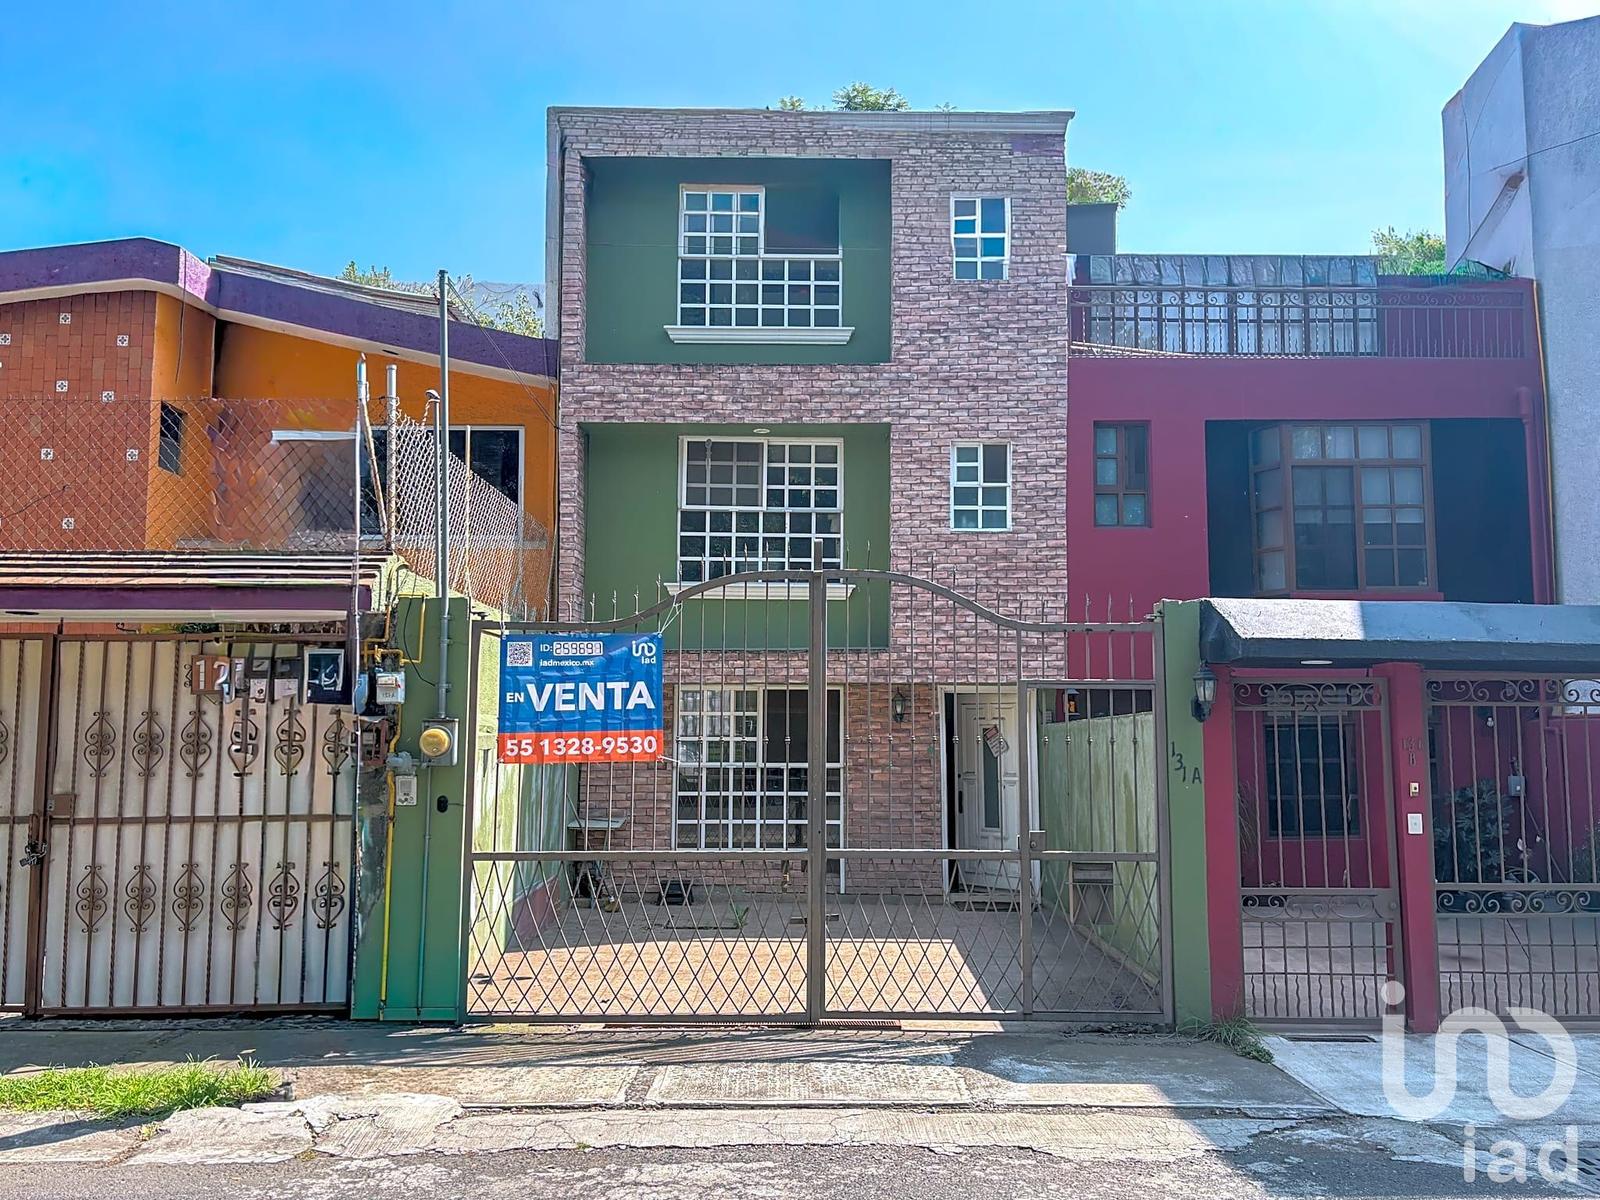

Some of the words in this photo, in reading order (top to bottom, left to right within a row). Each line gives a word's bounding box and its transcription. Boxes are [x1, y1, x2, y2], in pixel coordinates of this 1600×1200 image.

[540, 644, 553, 652] ID:
[540, 659, 594, 667] iadmexico.mx
[641, 656, 656, 664] iad
[506, 692, 525, 703] EN
[526, 681, 655, 712] VENTA
[506, 739, 533, 756] 55
[540, 736, 657, 756] 1328-9530
